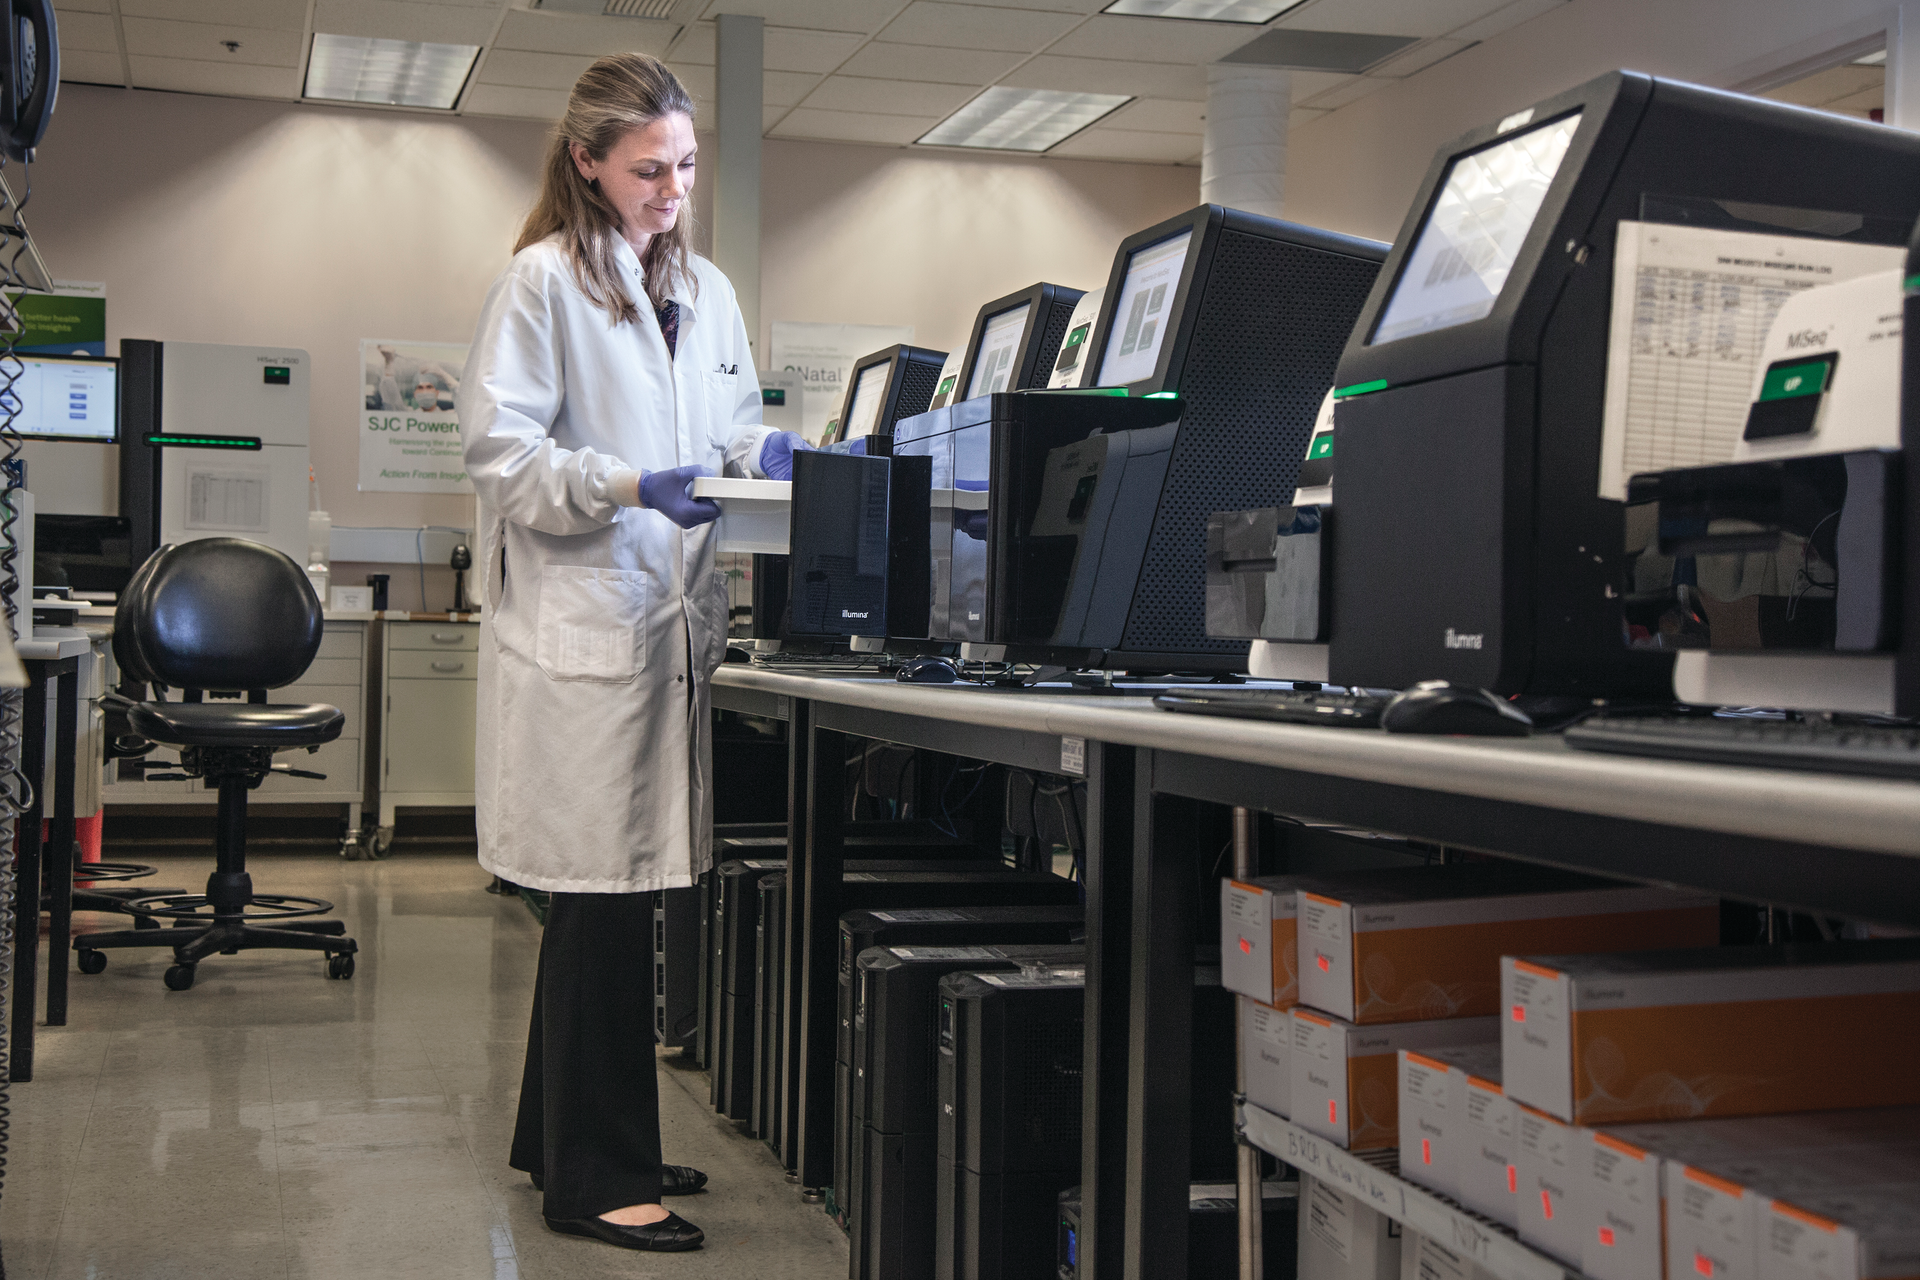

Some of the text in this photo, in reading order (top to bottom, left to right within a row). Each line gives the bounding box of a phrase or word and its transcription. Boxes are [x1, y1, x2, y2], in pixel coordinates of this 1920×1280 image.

[1783, 375, 1803, 392] UP
[368, 416, 401, 432] SJC
[1320, 443, 1330, 454] UP
[380, 469, 468, 482] Action From Insigh
[841, 609, 869, 618] illumina
[1445, 628, 1483, 650] illumina
